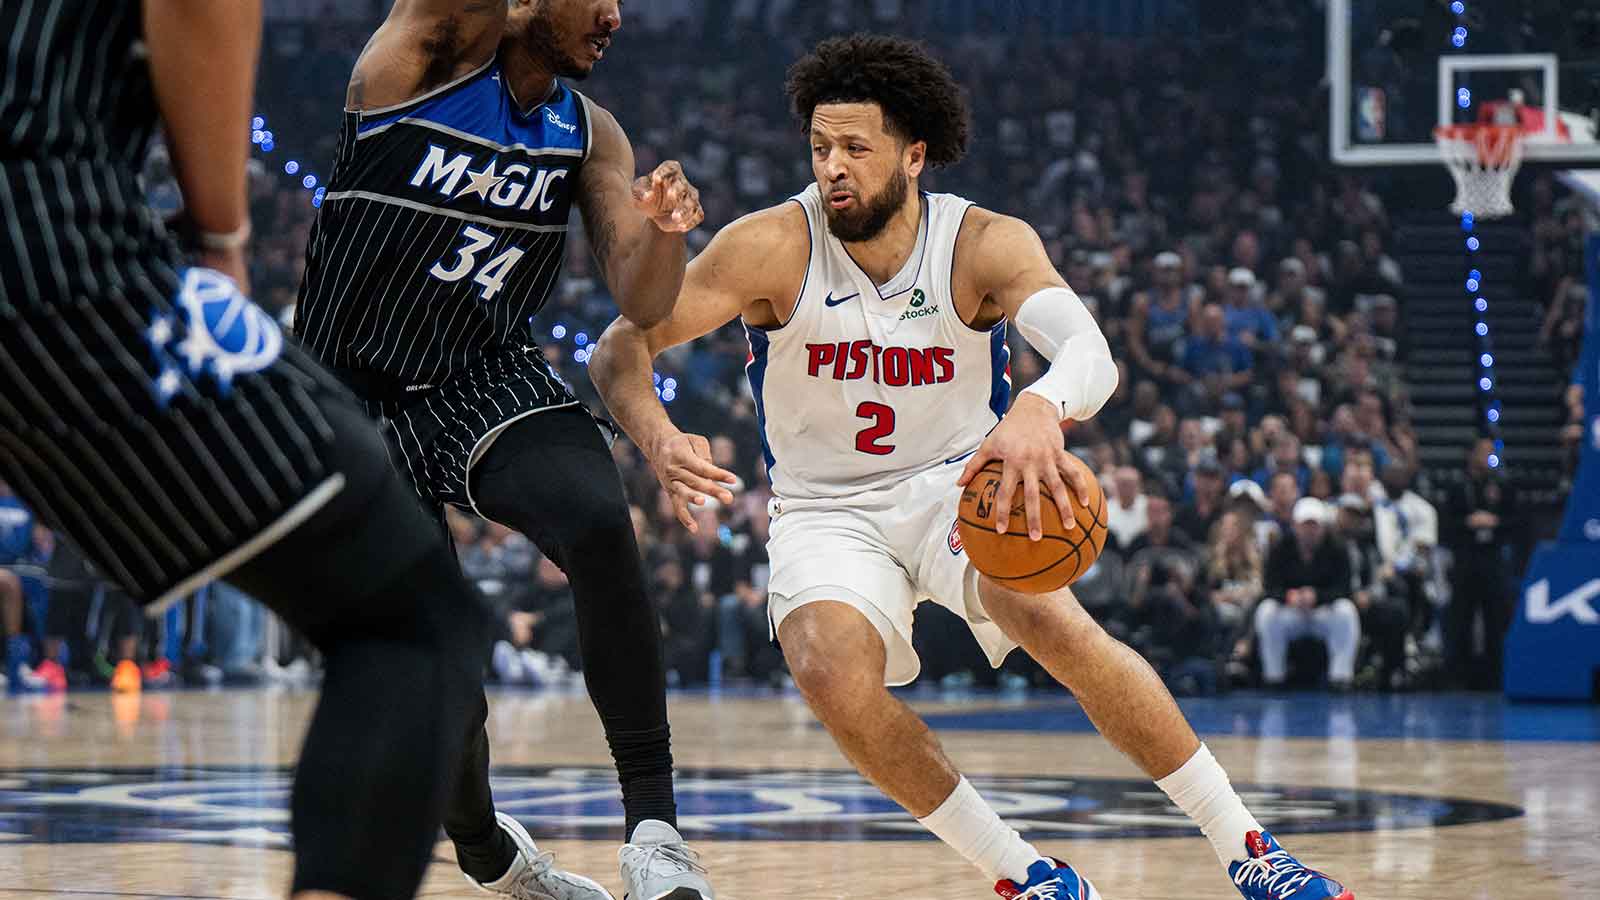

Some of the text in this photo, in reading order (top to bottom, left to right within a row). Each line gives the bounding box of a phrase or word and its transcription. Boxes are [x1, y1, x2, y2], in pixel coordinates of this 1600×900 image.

[429, 225, 526, 301] 34
[805, 339, 956, 387] PISTONS
[855, 401, 896, 456] 2
